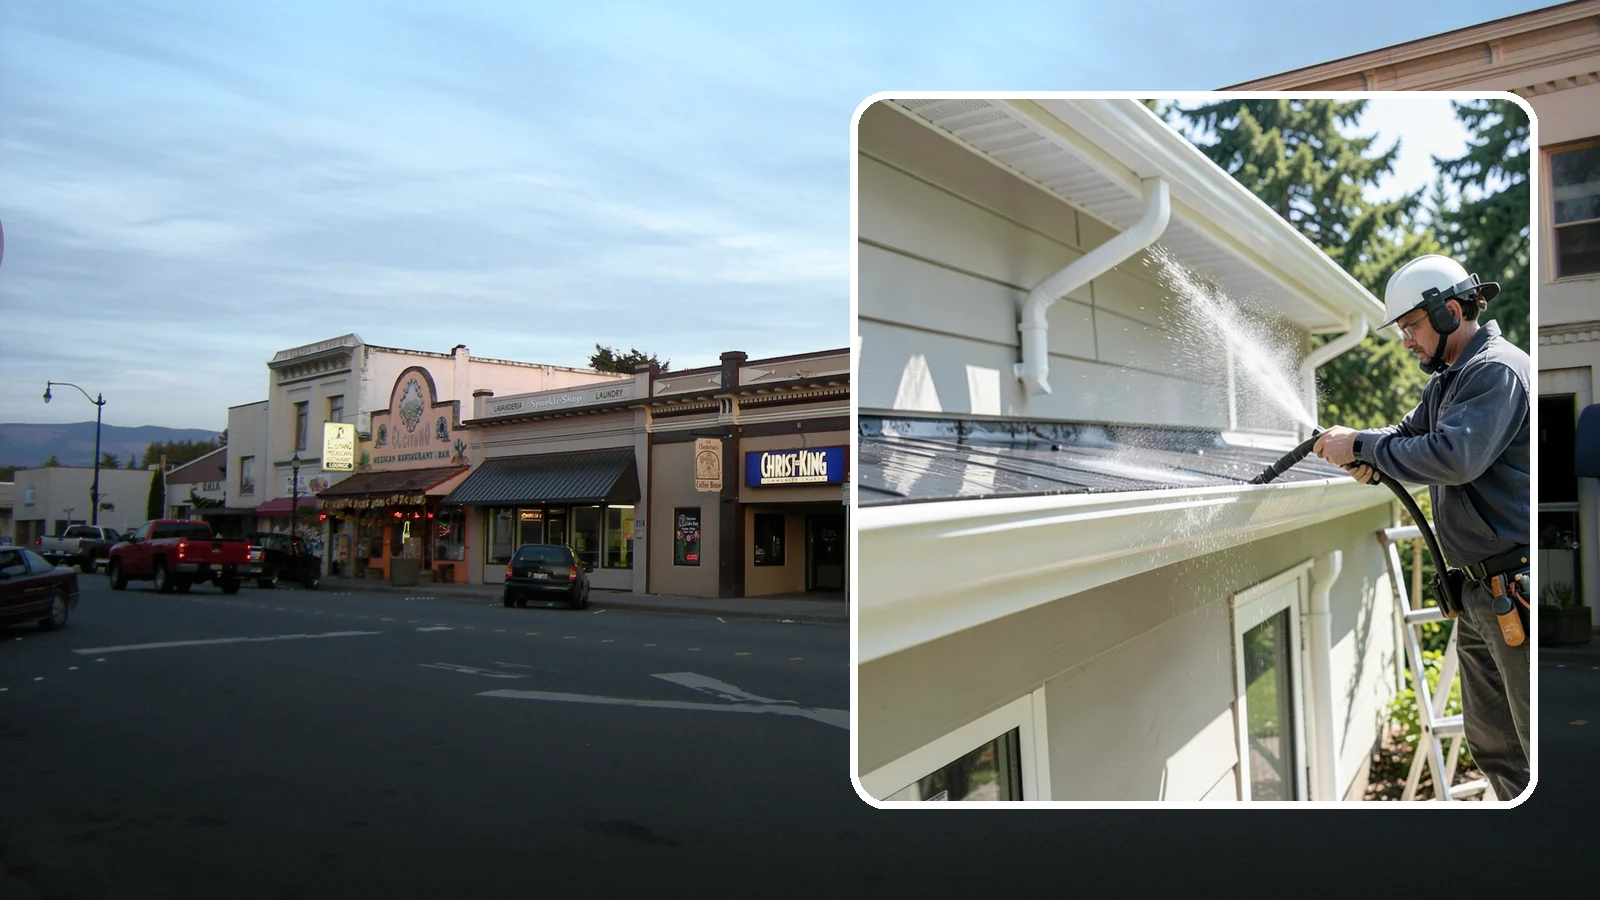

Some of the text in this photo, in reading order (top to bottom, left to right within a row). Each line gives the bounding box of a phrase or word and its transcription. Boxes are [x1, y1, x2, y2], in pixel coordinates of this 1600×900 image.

[595, 389, 623, 400] LAUNDRY
[493, 402, 522, 413] LAVANDERIA
[530, 394, 583, 409] Sparkle Shop
[392, 426, 402, 449] EL
[373, 455, 396, 464] MEXICAN
[397, 452, 433, 462] RESTAURANT
[438, 451, 450, 459] BAR
